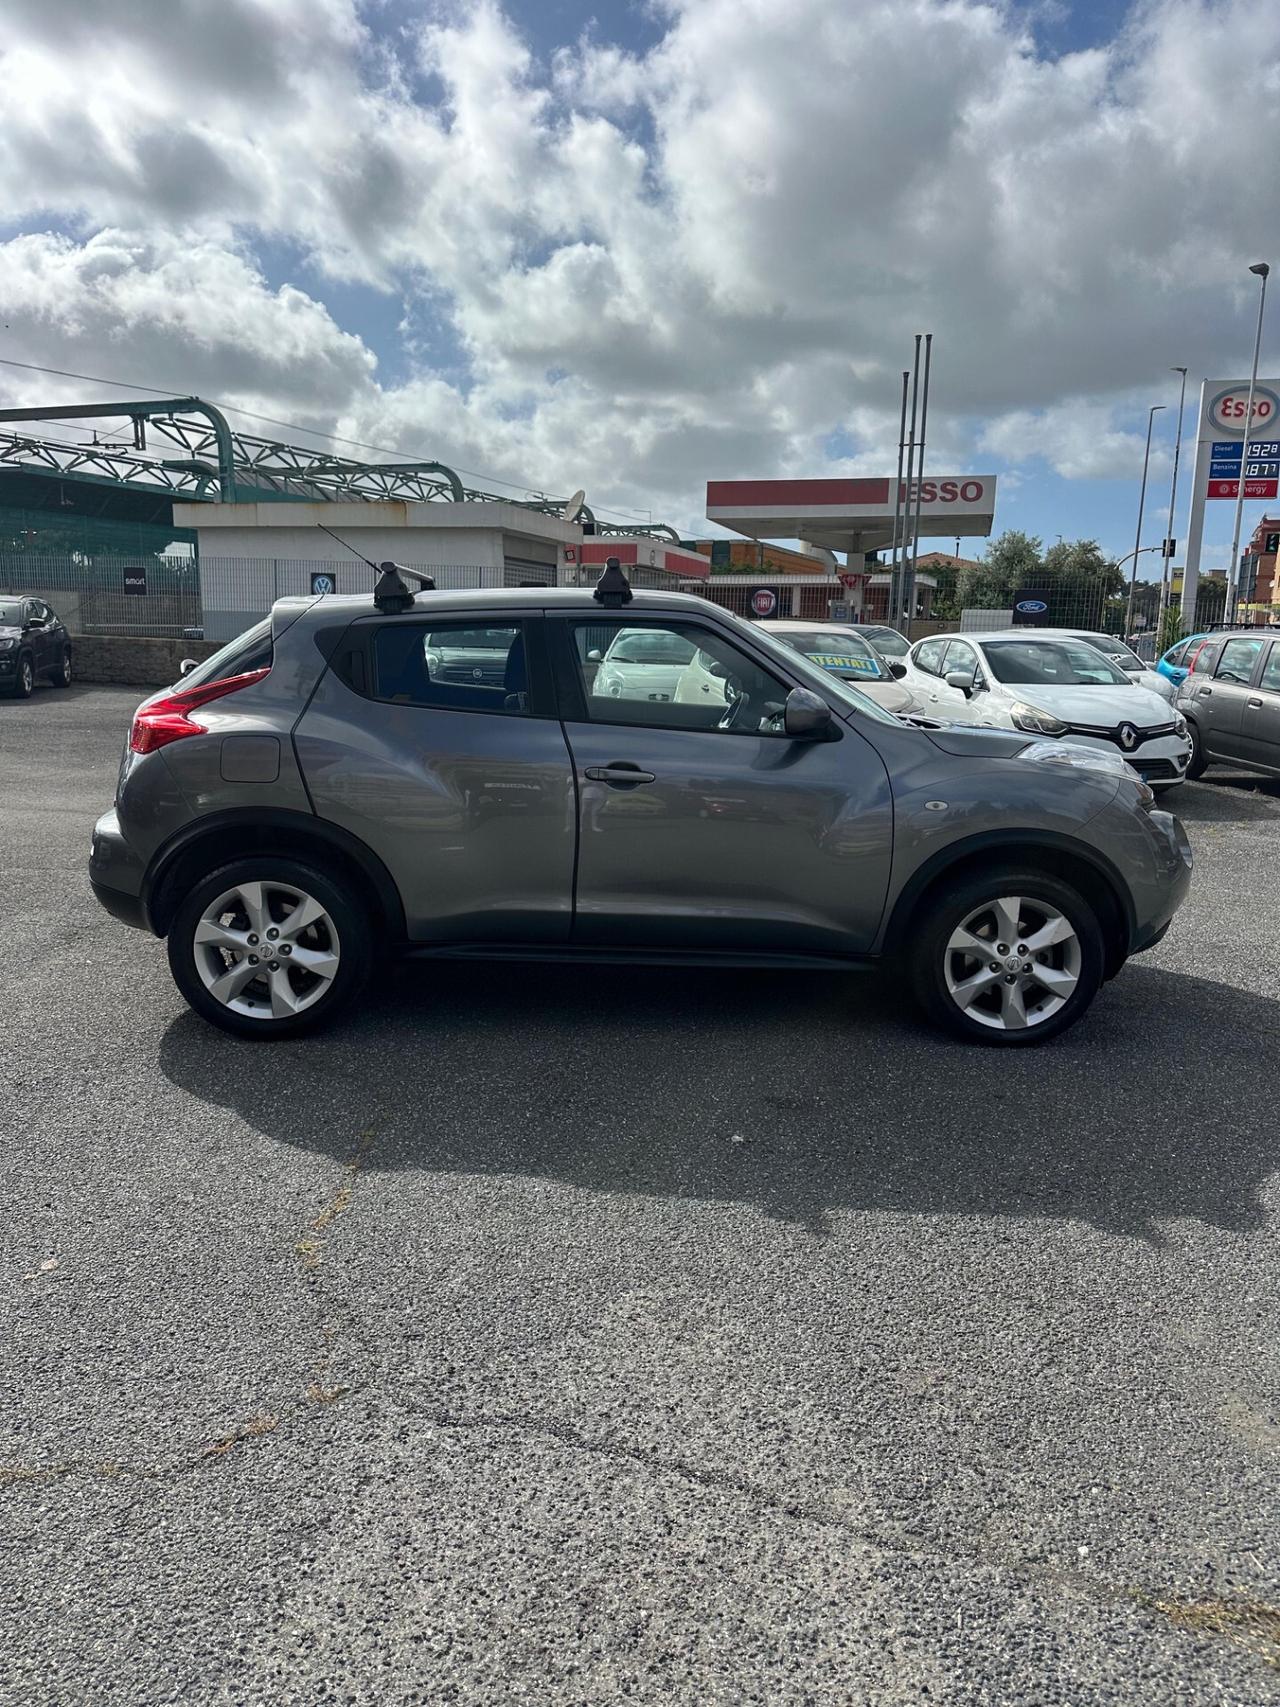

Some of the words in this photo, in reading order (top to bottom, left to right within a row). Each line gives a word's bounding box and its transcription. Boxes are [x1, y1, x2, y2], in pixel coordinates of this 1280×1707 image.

[899, 481, 984, 503] ESSO
[1232, 484, 1267, 495] Snergy
[125, 577, 145, 585] smart
[757, 597, 770, 608] FIAT
